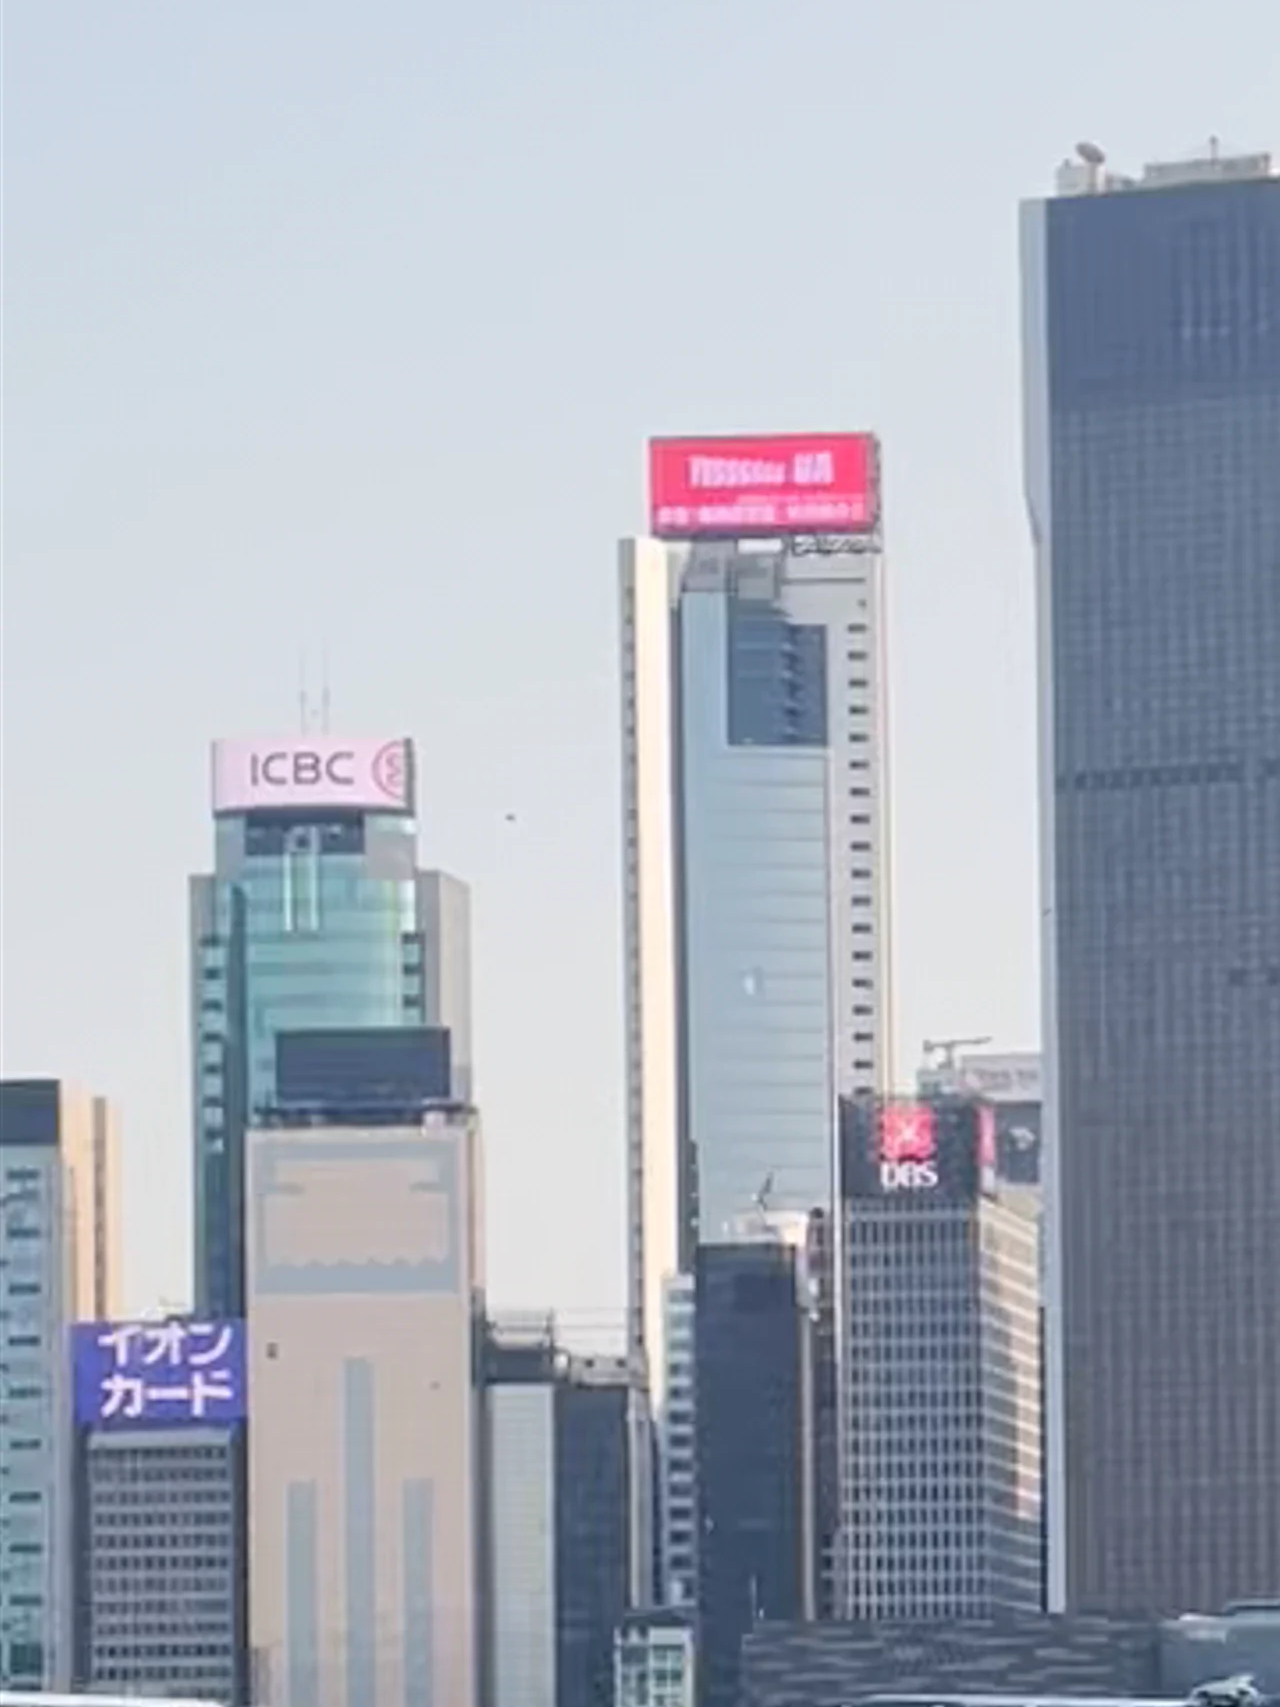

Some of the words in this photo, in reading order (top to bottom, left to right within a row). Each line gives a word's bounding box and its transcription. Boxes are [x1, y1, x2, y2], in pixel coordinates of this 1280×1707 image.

[250, 751, 356, 786] ICBC
[880, 1161, 938, 1190] DBS
[98, 1322, 234, 1367] イオン
[101, 1369, 235, 1419] カード
